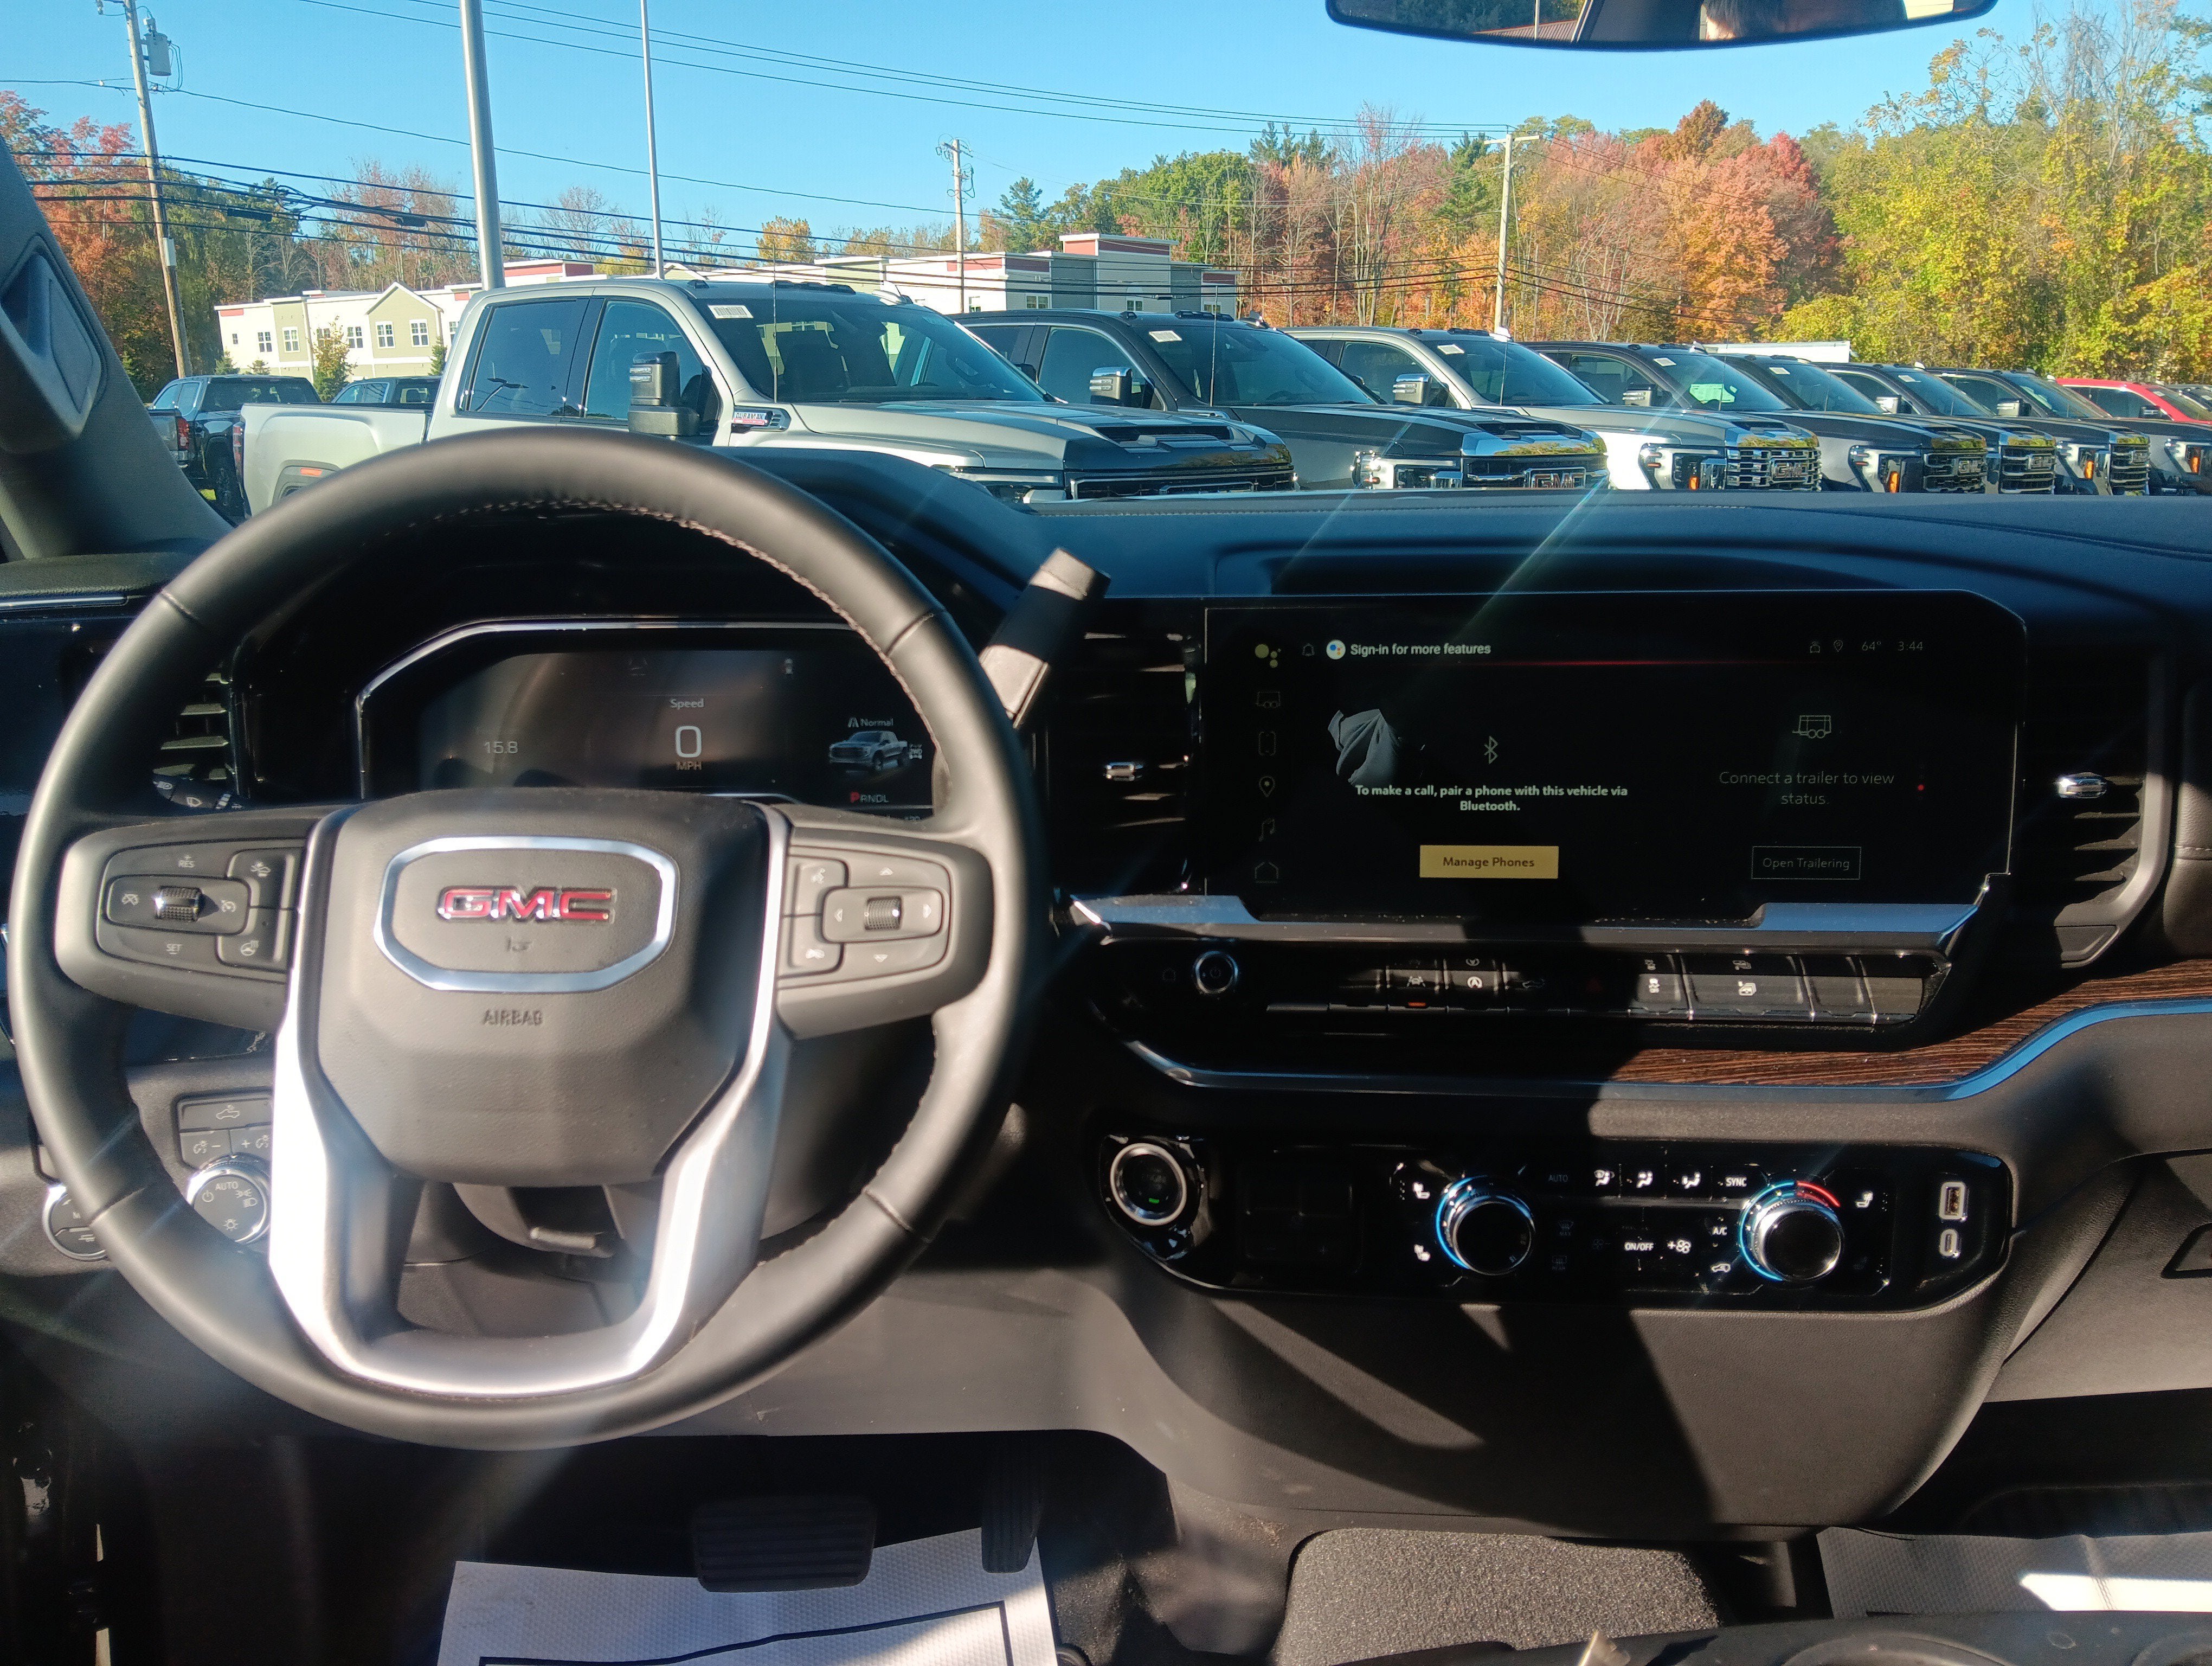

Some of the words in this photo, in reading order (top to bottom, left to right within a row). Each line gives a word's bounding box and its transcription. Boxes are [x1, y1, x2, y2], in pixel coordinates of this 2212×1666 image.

[1775, 463, 1808, 478] GMC
[1531, 473, 1584, 488] GMC
[1350, 643, 1389, 657] Sign-in
[1392, 643, 1409, 655] for
[1411, 645, 1441, 655] more
[1443, 643, 1491, 655] features
[1896, 641, 1924, 651] 3:44
[670, 697, 705, 710] Speed
[860, 717, 894, 727] Normal
[675, 725, 702, 758] 0
[676, 761, 703, 771] MPH
[1719, 771, 1780, 784] Connect
[1784, 775, 1792, 784] a
[1796, 771, 1838, 784] trailer
[1843, 773, 1857, 784] to
[1861, 772, 1894, 784] view
[850, 791, 889, 803] PRNDL
[1355, 785, 1369, 796] To
[1372, 785, 1402, 796] make
[1414, 785, 1438, 798] call,
[1439, 785, 1463, 798] pair
[1475, 785, 1512, 798] phone
[1514, 785, 1540, 796] with
[1542, 785, 1565, 796] this
[1566, 785, 1609, 796] vehicle
[1610, 785, 1628, 796] via
[1780, 793, 1829, 805] status.
[1459, 800, 1521, 811] Bluetooth.
[178, 860, 195, 868] RES
[1442, 856, 1489, 869] Manage
[1491, 856, 1535, 868] Phones
[1762, 858, 1794, 870] Open
[1796, 857, 1850, 870] Trailering
[436, 885, 617, 923] GMC
[166, 943, 183, 952] SET
[481, 1009, 543, 1026] AIRBAG
[1548, 1174, 1569, 1183] AUTO
[1725, 1176, 1747, 1187] SYNC
[215, 1181, 239, 1191] AUTO
[1712, 1226, 1728, 1236] A/C
[1624, 1241, 1655, 1252] ON/OFF
